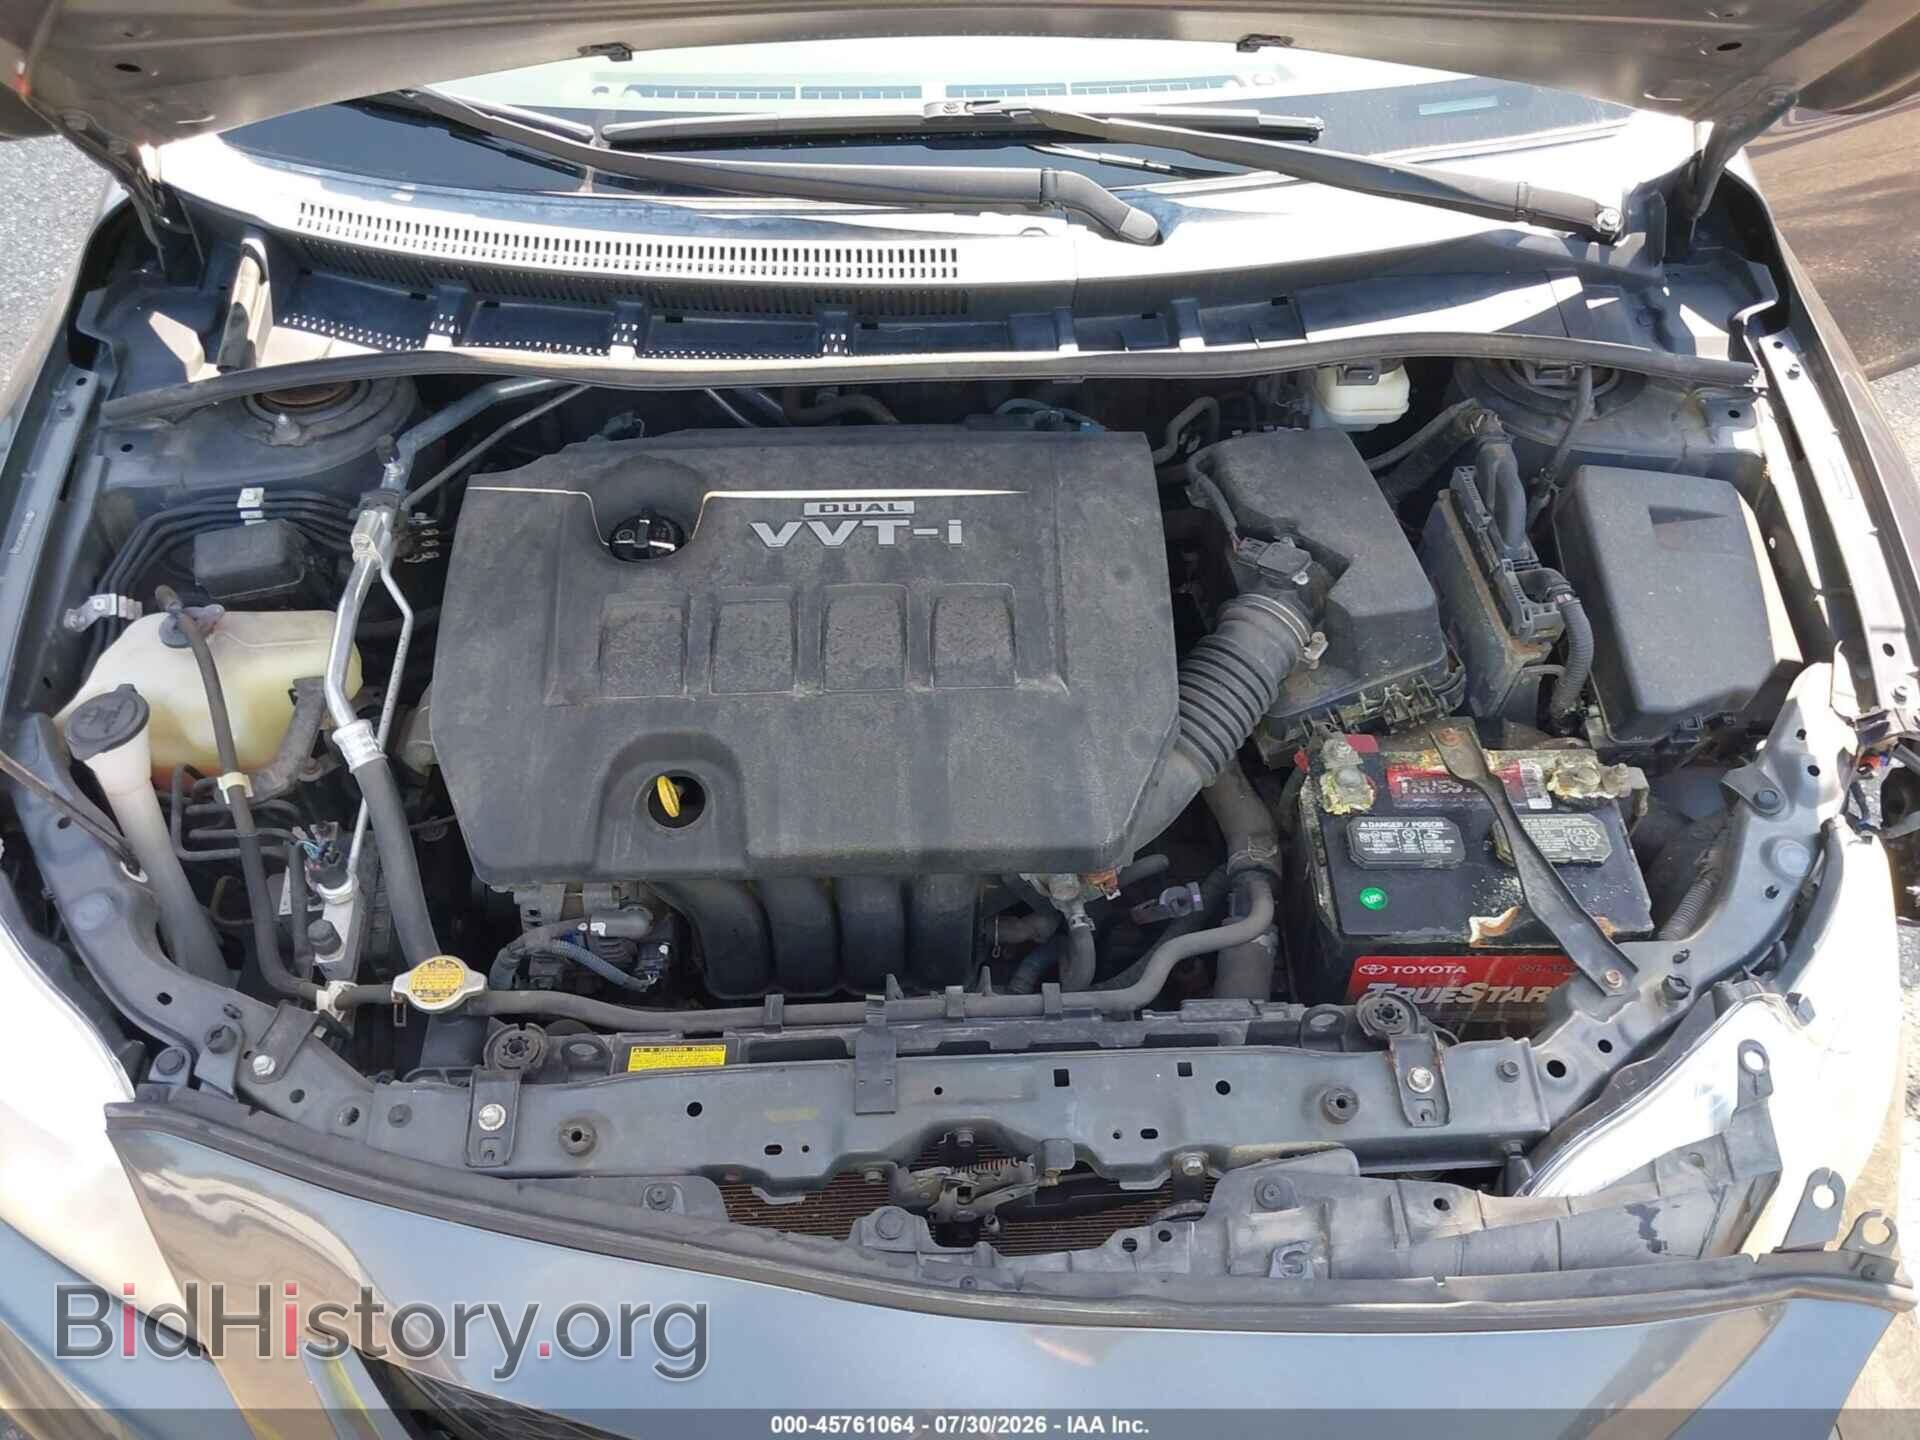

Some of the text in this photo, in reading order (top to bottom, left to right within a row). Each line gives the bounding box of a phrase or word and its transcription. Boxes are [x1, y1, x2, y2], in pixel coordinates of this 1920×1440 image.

[818, 503, 905, 513] DUAL
[748, 519, 963, 548] VVT-i
[1391, 965, 1467, 975] TOYOTA
